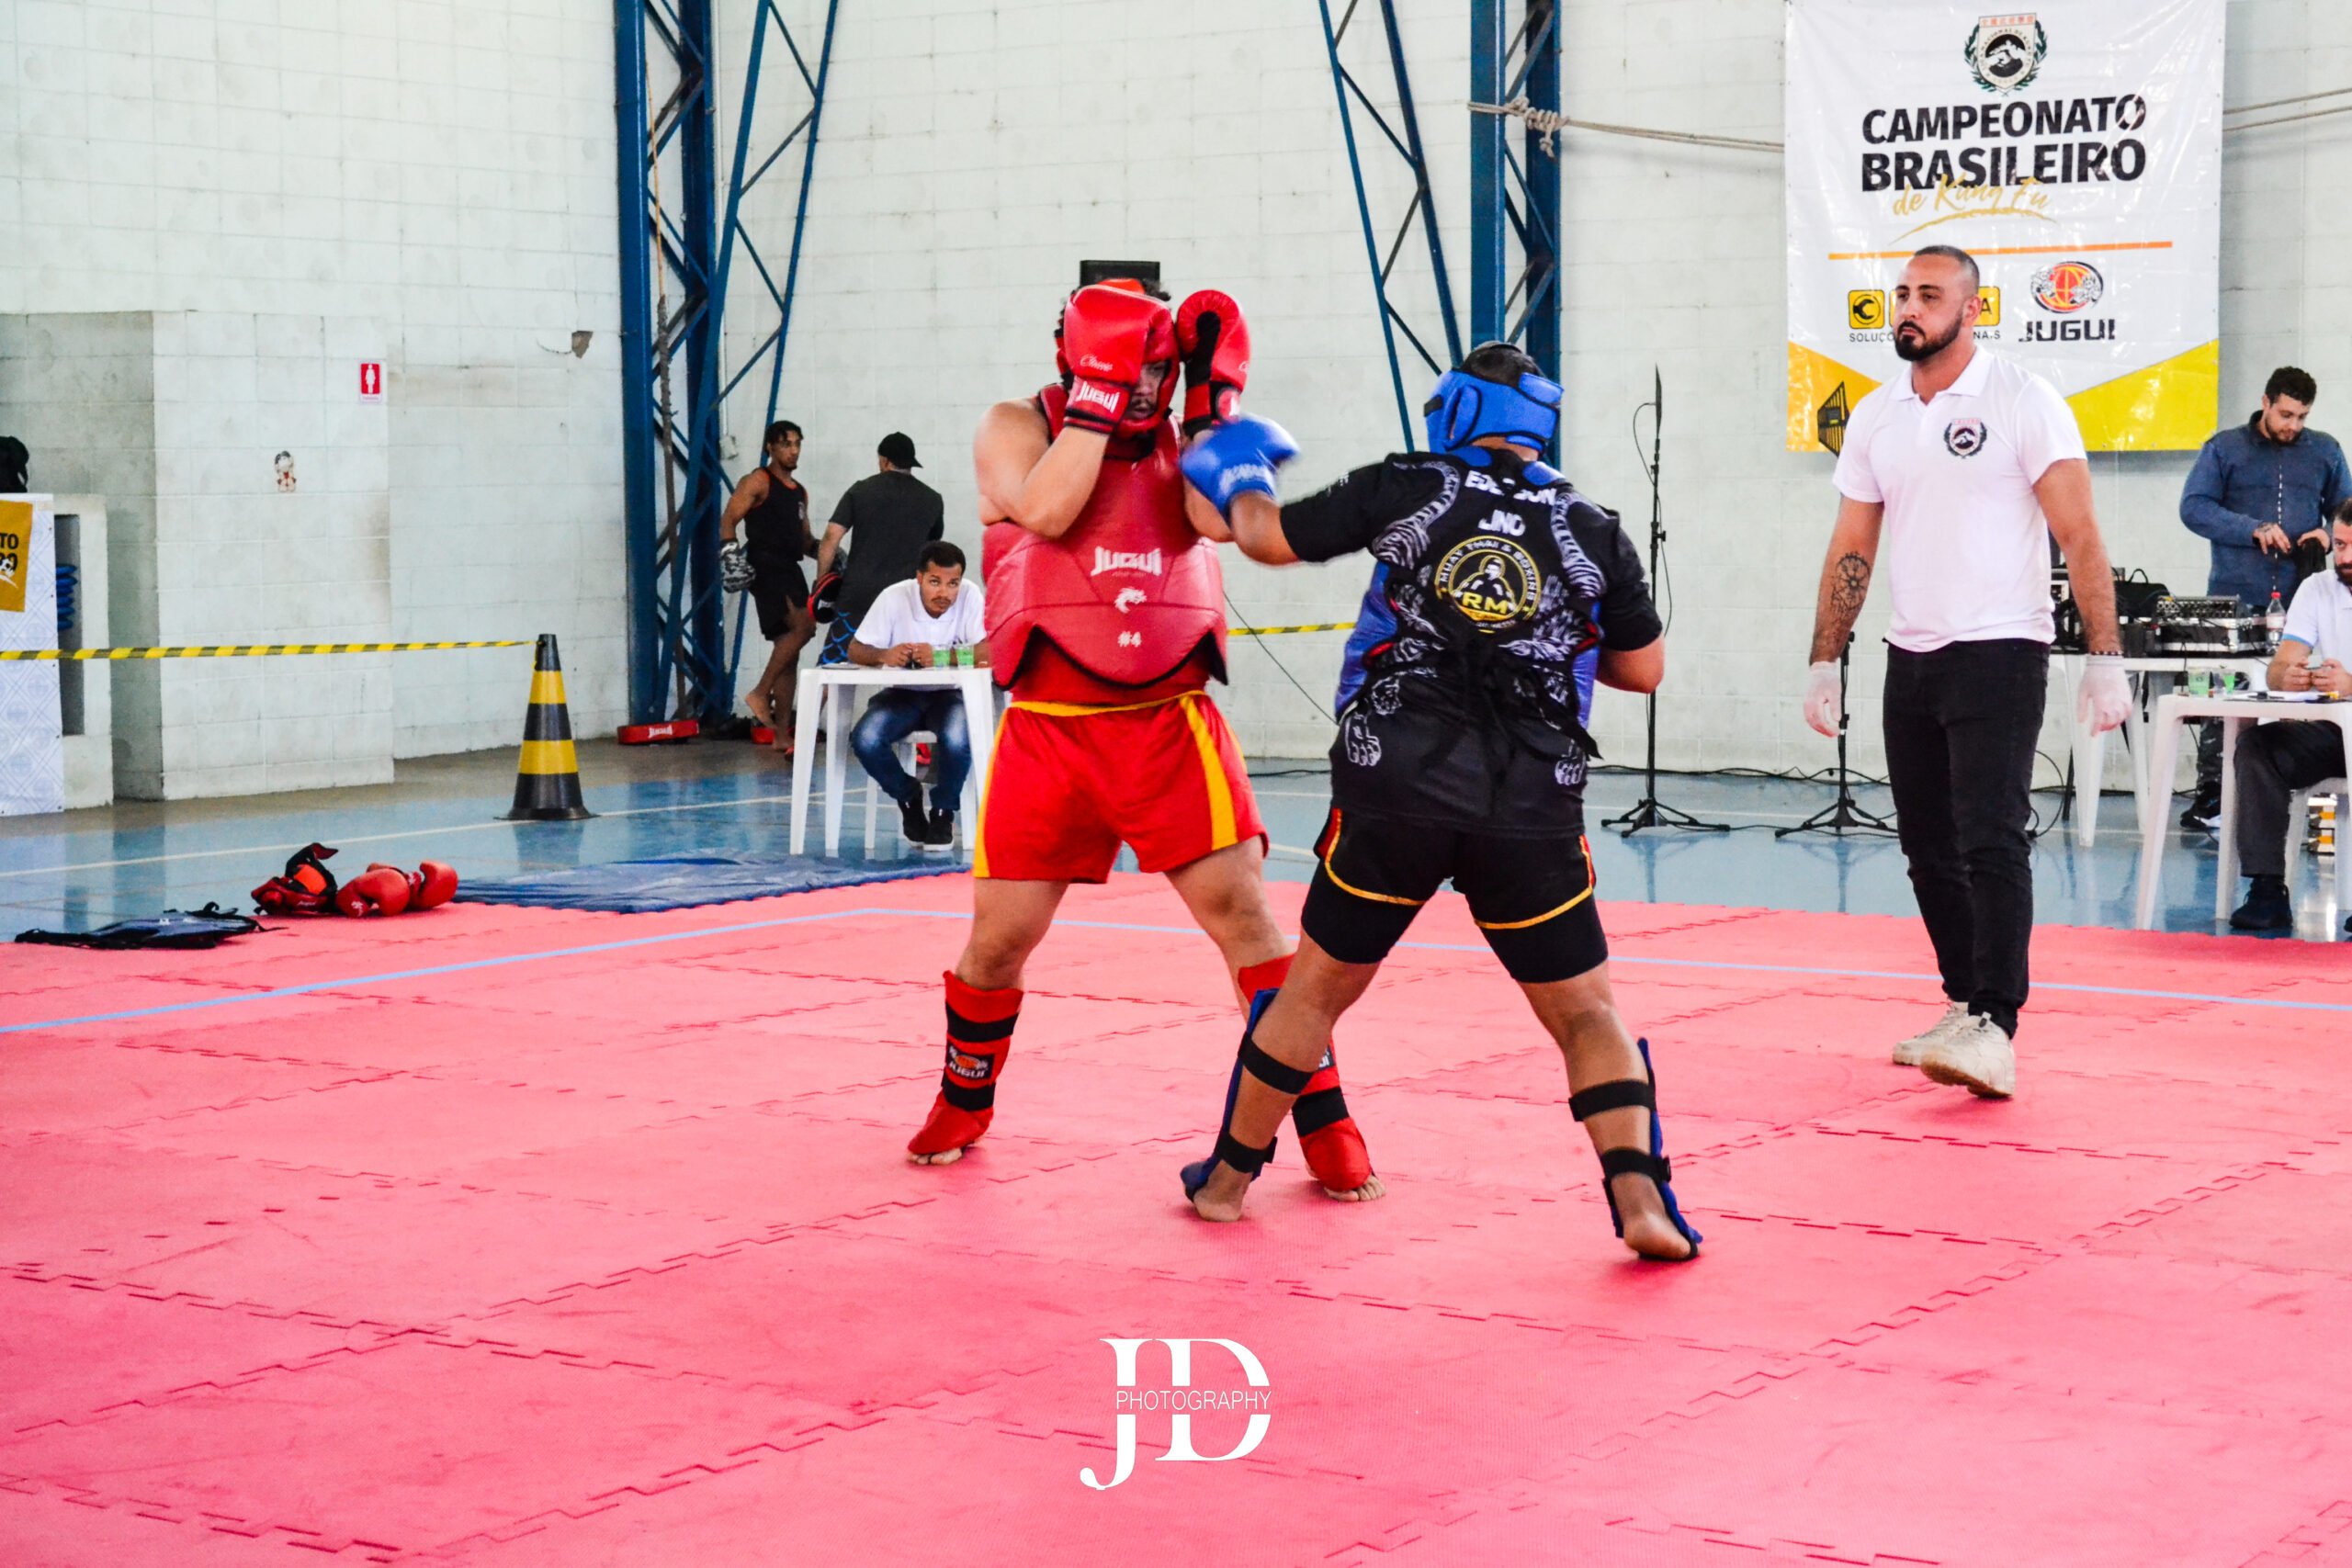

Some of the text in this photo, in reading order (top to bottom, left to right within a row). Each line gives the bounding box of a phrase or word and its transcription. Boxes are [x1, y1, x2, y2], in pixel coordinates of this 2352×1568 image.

[1862, 94, 2146, 144] CAMPEONATO
[1861, 139, 2146, 192] BRASILEIRO
[1894, 172, 2051, 215] de Kung Fu
[2018, 319, 2115, 342] JUGUI
[1091, 546, 1162, 577] JUGUI
[1440, 548, 1464, 582] MUAY
[1513, 551, 1537, 601] BOXING
[1462, 591, 1510, 615] RM
[1117, 630, 1142, 648] #4
